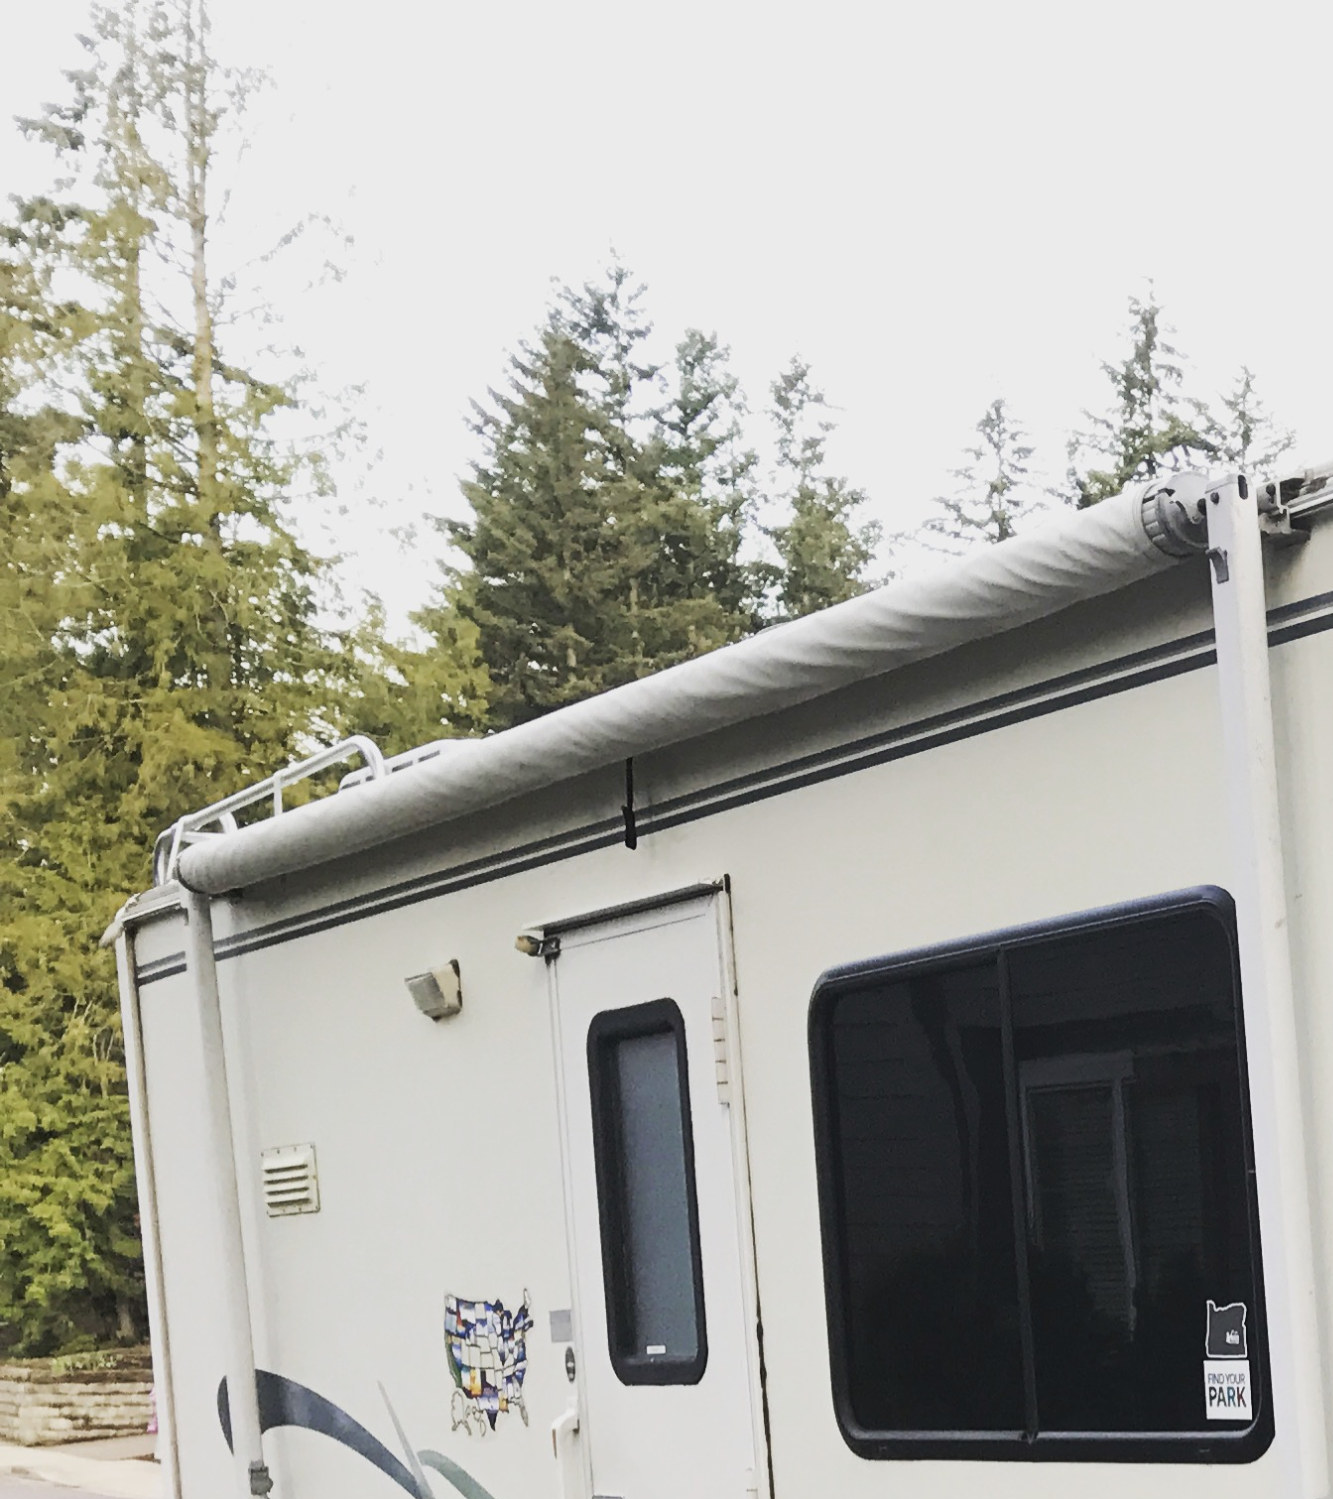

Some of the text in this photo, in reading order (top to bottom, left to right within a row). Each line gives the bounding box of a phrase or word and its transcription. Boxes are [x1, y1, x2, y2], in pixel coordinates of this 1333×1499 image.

[1207, 1373, 1246, 1385] FIND YOUR
[1208, 1386, 1247, 1408] PARK
